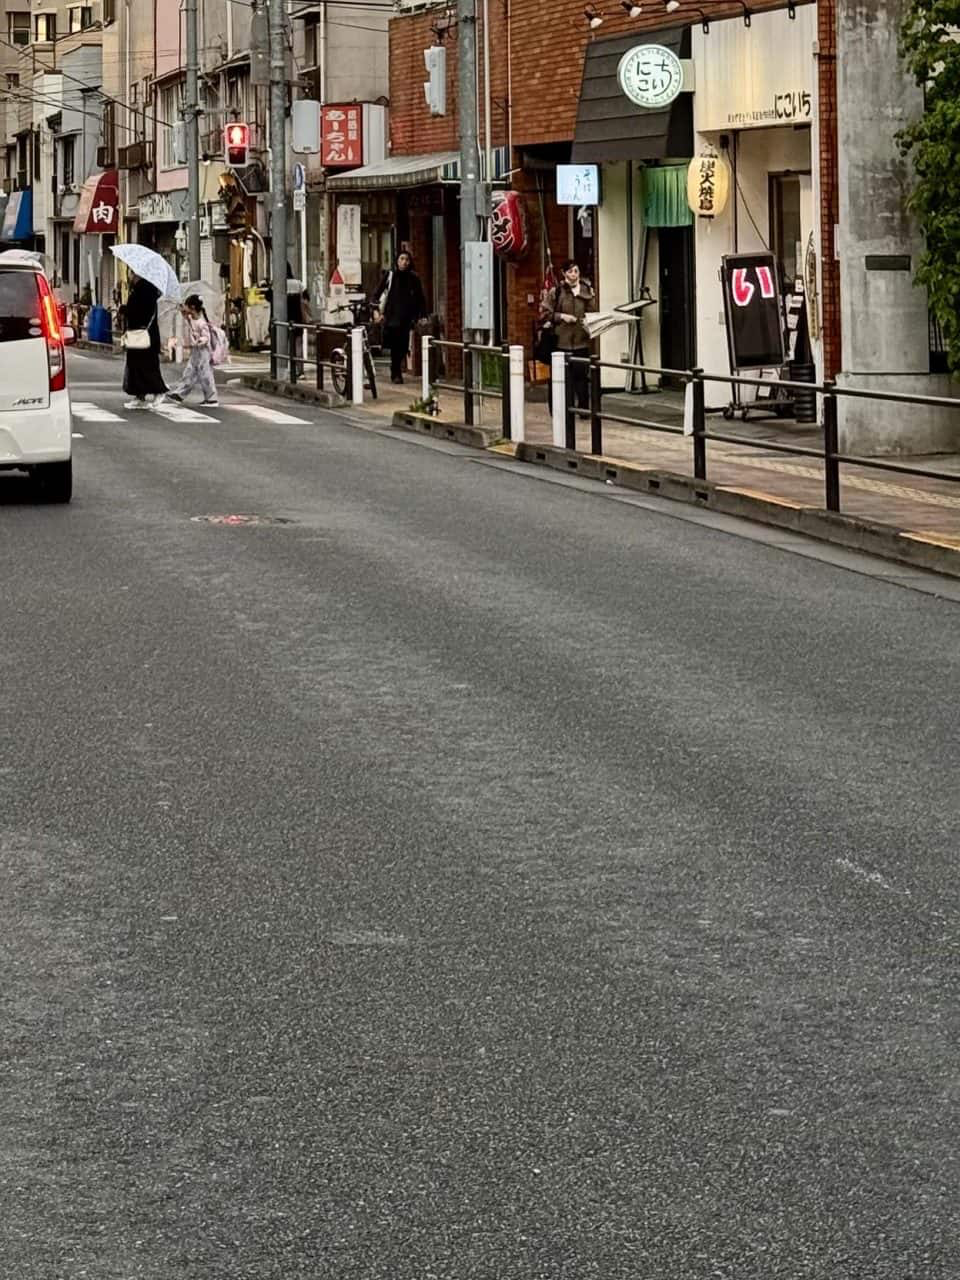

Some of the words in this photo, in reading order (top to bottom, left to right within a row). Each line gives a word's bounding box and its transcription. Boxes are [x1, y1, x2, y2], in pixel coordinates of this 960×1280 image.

[774, 89, 812, 119] にこいち
[92, 201, 115, 225] 肉
